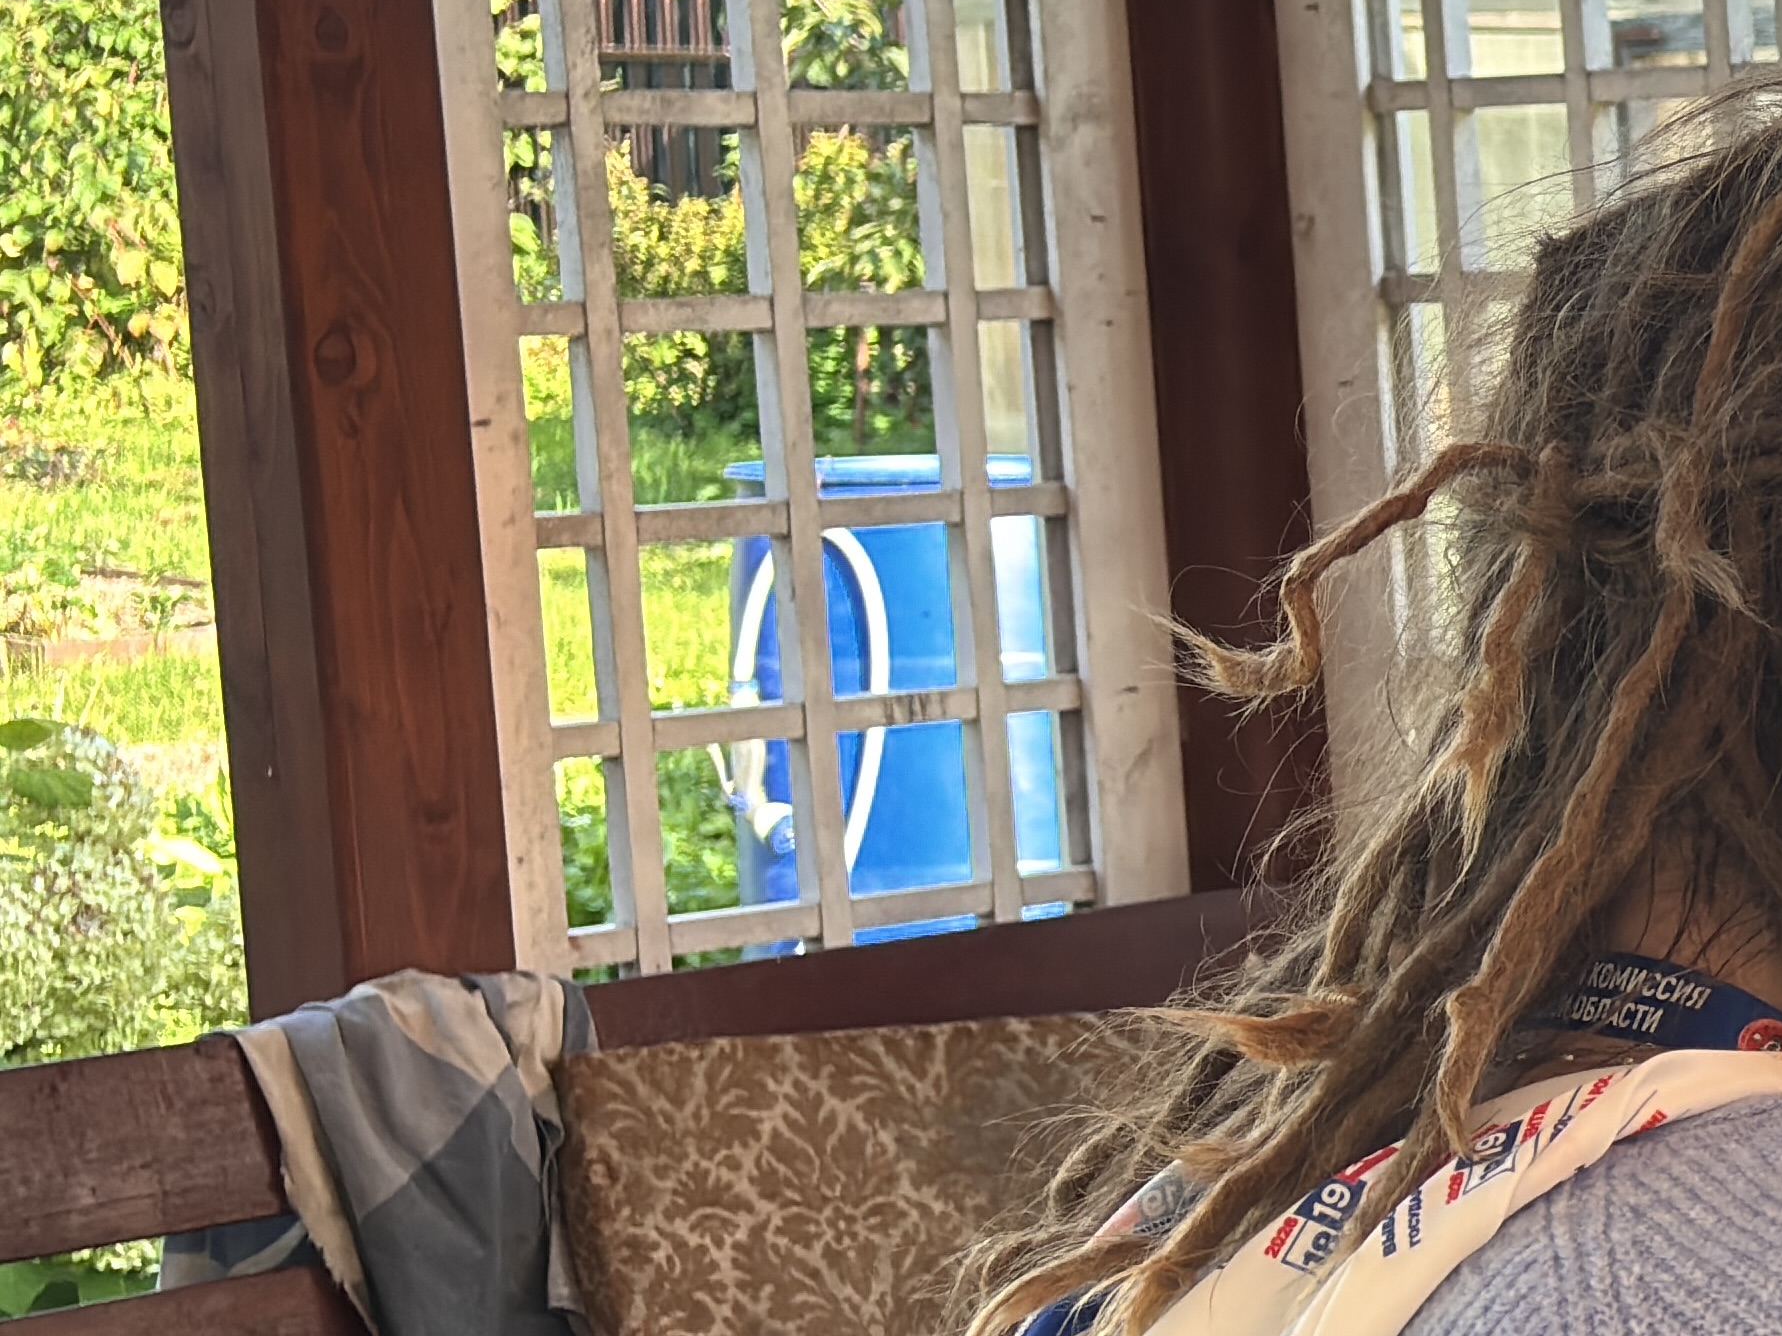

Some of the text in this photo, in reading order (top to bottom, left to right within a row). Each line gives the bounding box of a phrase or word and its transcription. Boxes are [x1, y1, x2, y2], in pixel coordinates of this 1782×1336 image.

[1588, 962, 1712, 1009] КОМИССИЯ
[1312, 1182, 1351, 1226] 19
[1264, 1216, 1299, 1259] 2026
